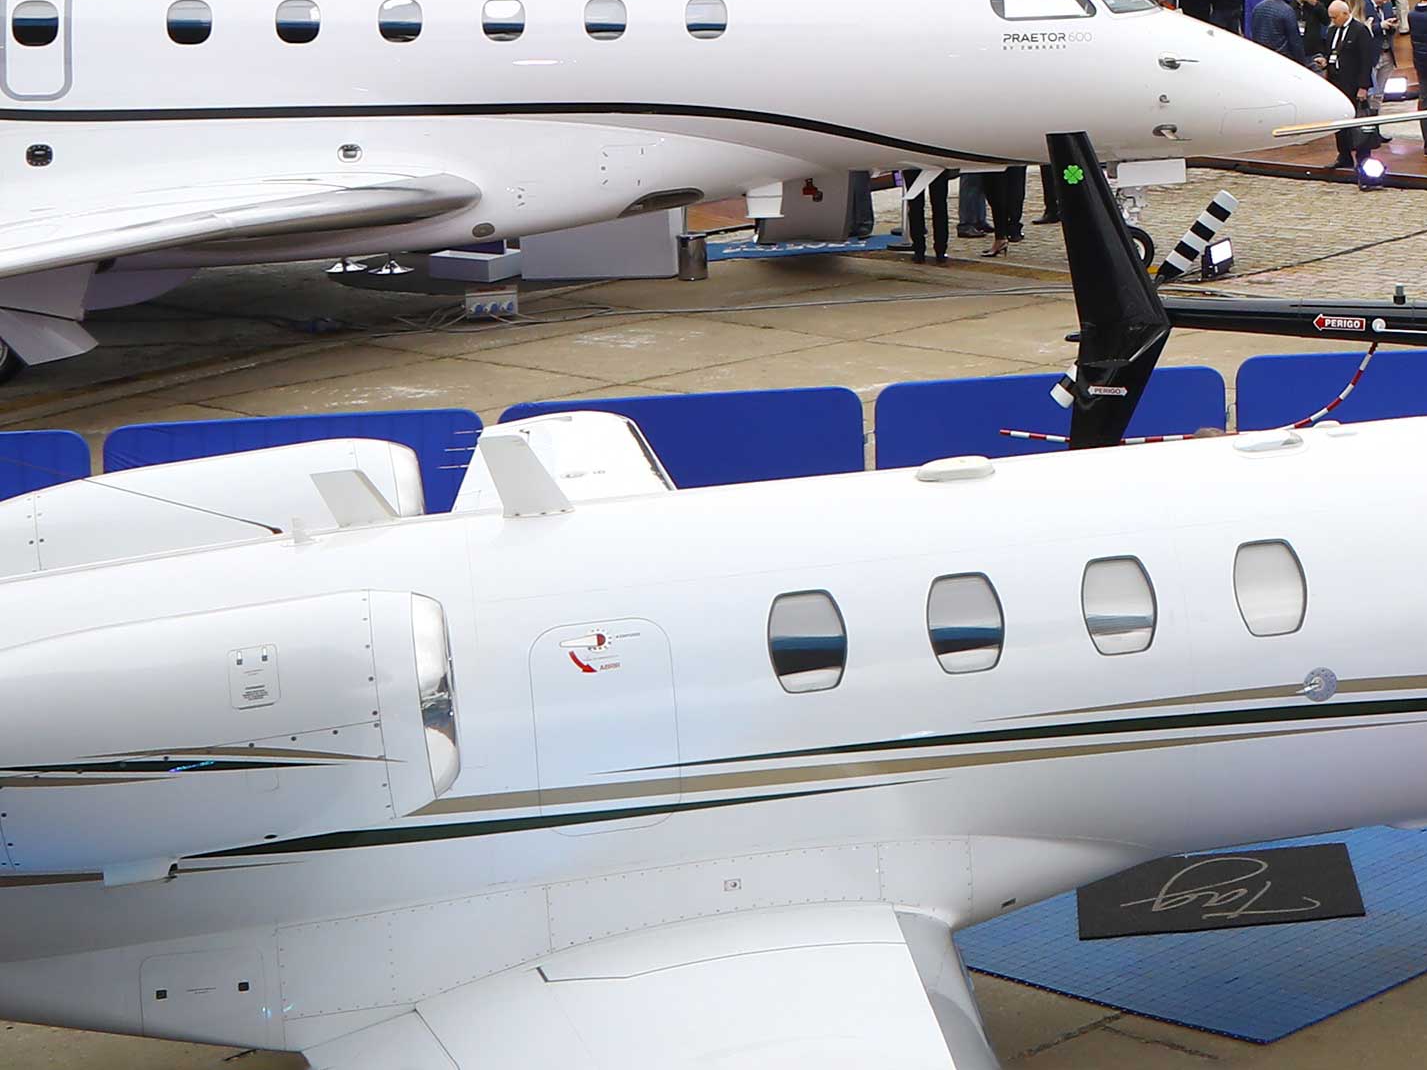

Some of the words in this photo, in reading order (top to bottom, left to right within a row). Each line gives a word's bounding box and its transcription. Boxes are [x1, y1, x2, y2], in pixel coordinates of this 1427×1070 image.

[1003, 32, 1067, 43] PRAETOR
[1068, 31, 1093, 42] 600
[1324, 318, 1361, 329] PERIGO
[1093, 387, 1122, 395] PERIGO
